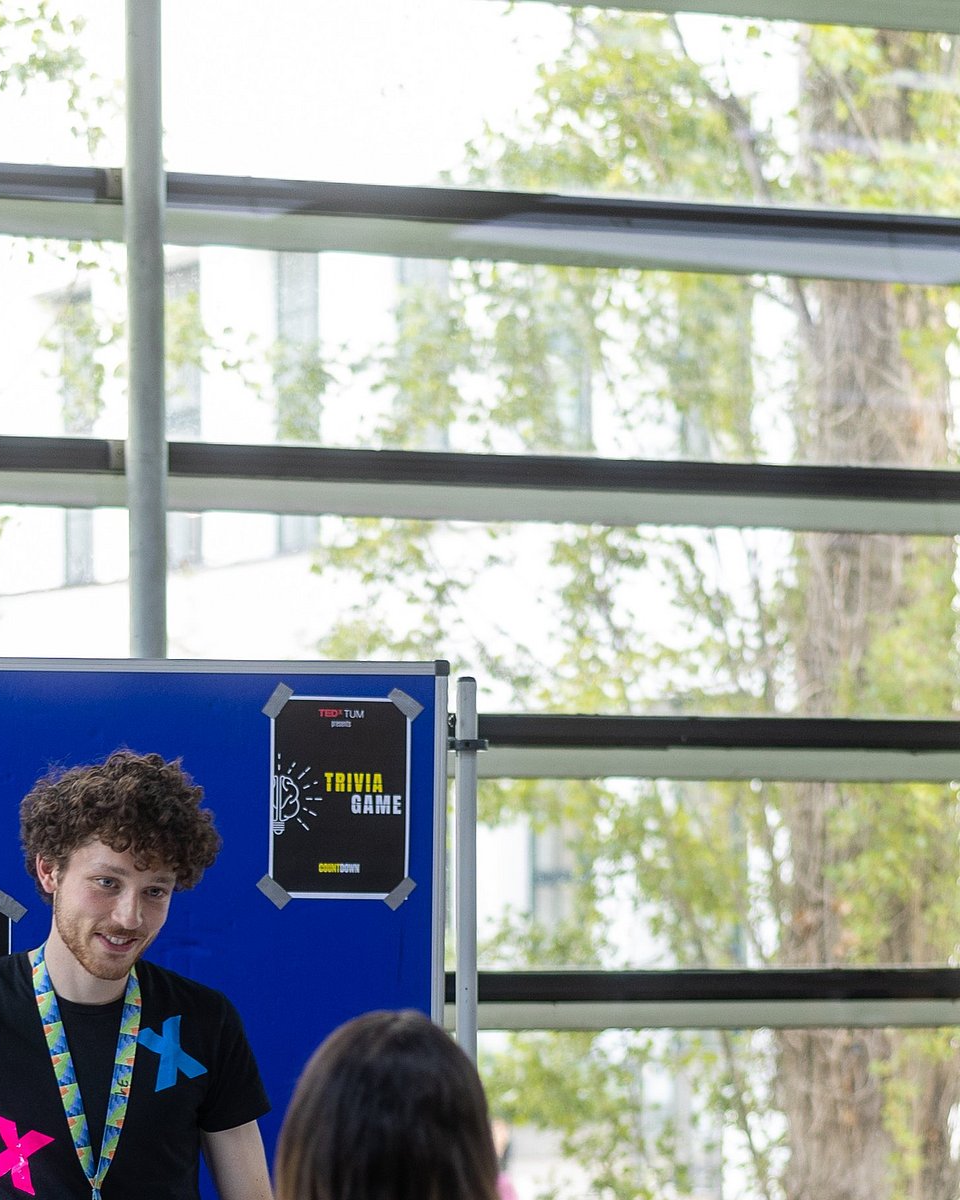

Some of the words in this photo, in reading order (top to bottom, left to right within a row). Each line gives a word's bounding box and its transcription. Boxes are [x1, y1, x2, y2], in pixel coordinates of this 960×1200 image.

[324, 772, 383, 793] TRIVIA
[351, 794, 402, 815] GAME
[318, 862, 360, 873] COUNTDOWN
